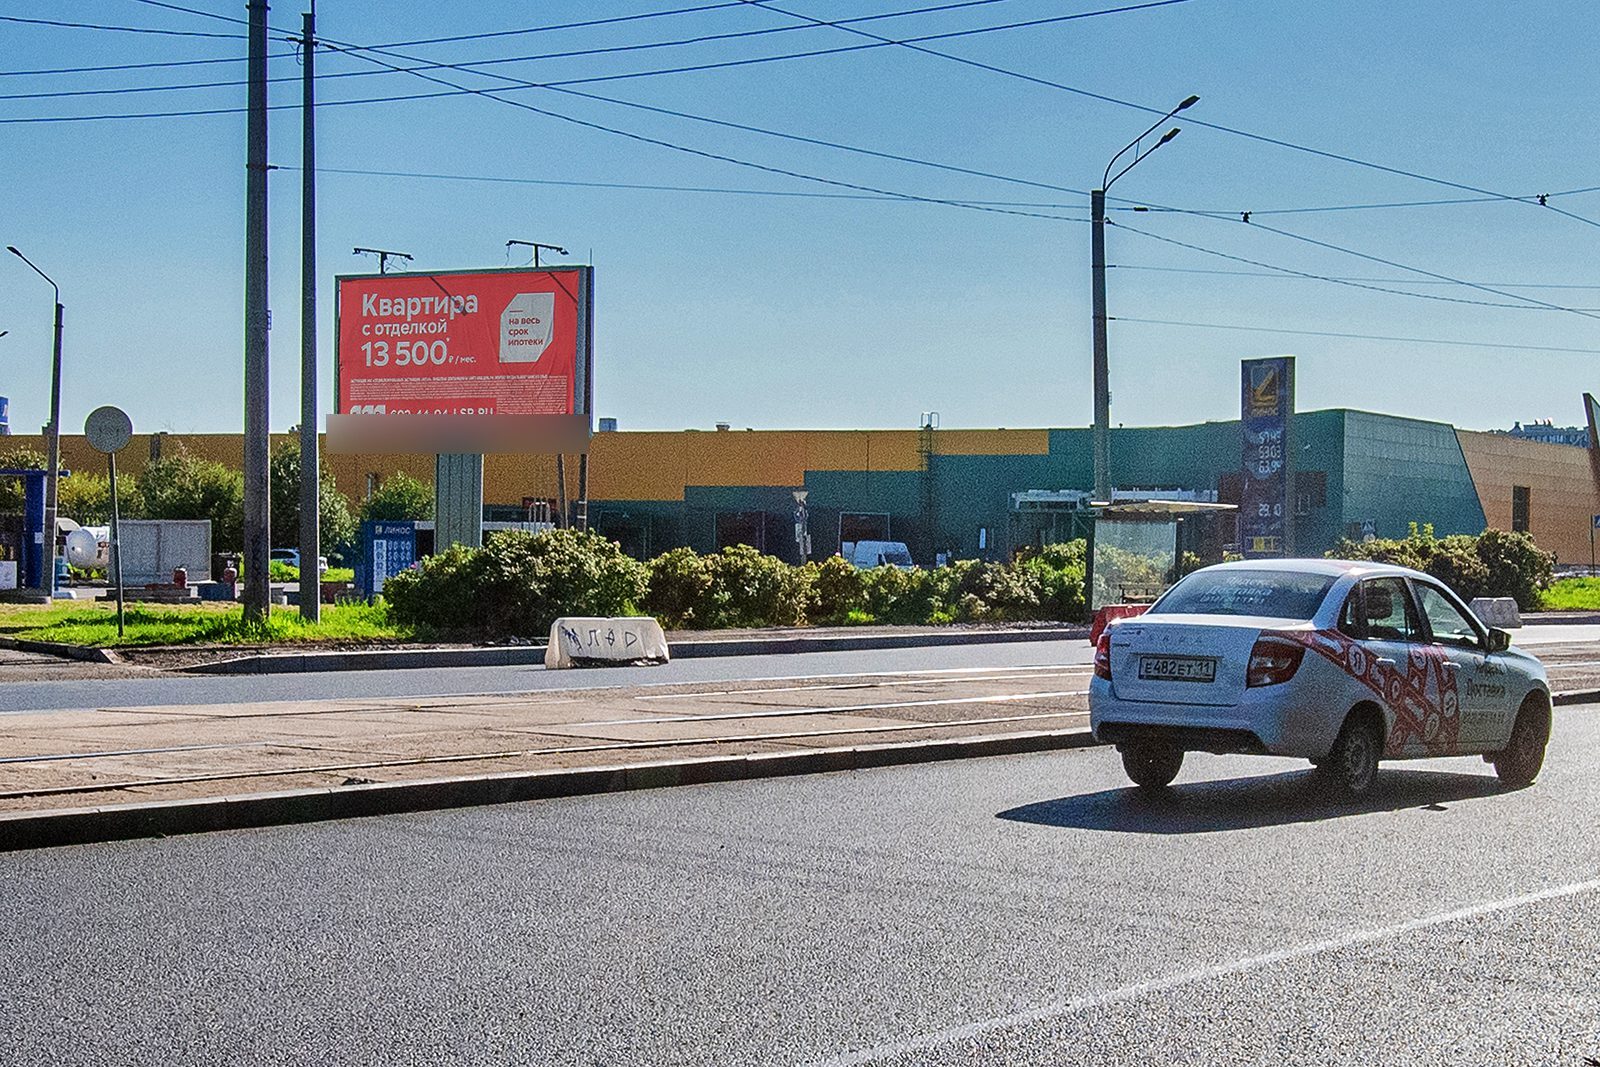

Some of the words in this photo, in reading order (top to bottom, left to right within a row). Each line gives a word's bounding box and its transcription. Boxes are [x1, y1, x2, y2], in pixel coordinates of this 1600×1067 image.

[362, 293, 478, 321] Квартира
[362, 324, 371, 336] с
[374, 319, 447, 337] отделкой
[521, 317, 541, 325] весь
[508, 328, 529, 337] срок
[361, 341, 389, 367] 13
[1145, 660, 1194, 675] Е482ЕТ
